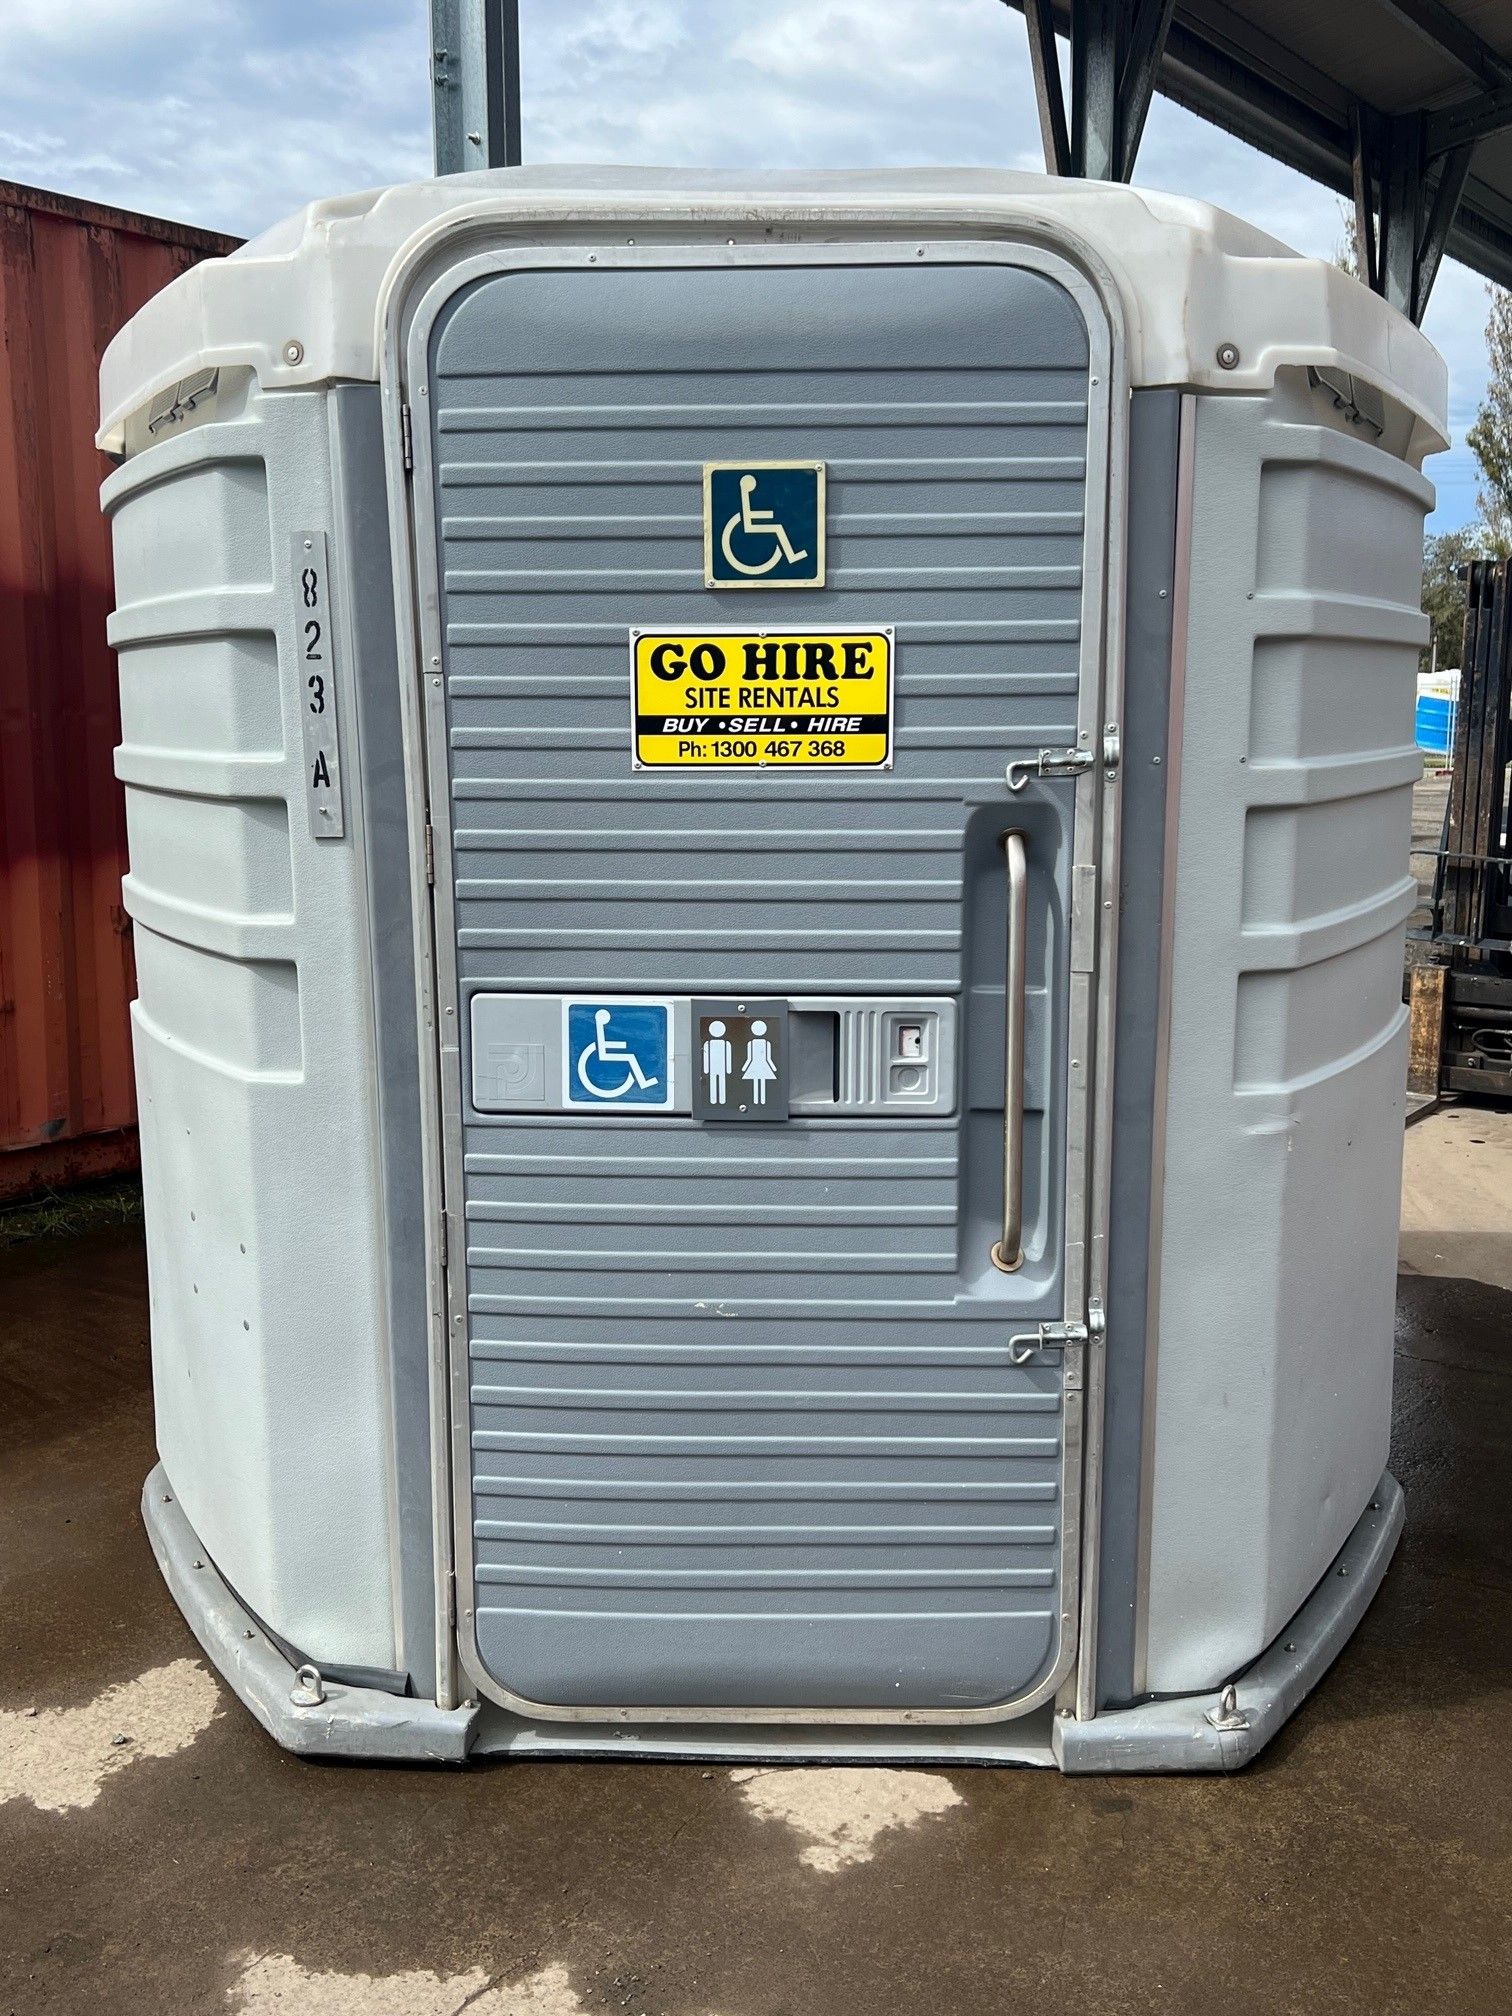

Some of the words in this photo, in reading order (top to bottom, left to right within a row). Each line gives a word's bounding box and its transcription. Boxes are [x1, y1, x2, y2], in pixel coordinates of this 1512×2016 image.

[650, 643, 726, 681] GO
[742, 642, 874, 681] HIRE
[685, 687, 730, 708] SITE
[739, 686, 840, 708] RENTALS
[662, 718, 709, 733] BUY
[807, 717, 863, 732] HIRE
[678, 741, 707, 757] Ph:
[712, 741, 757, 757] 1300
[764, 741, 802, 757] 467
[808, 741, 845, 757] 368
